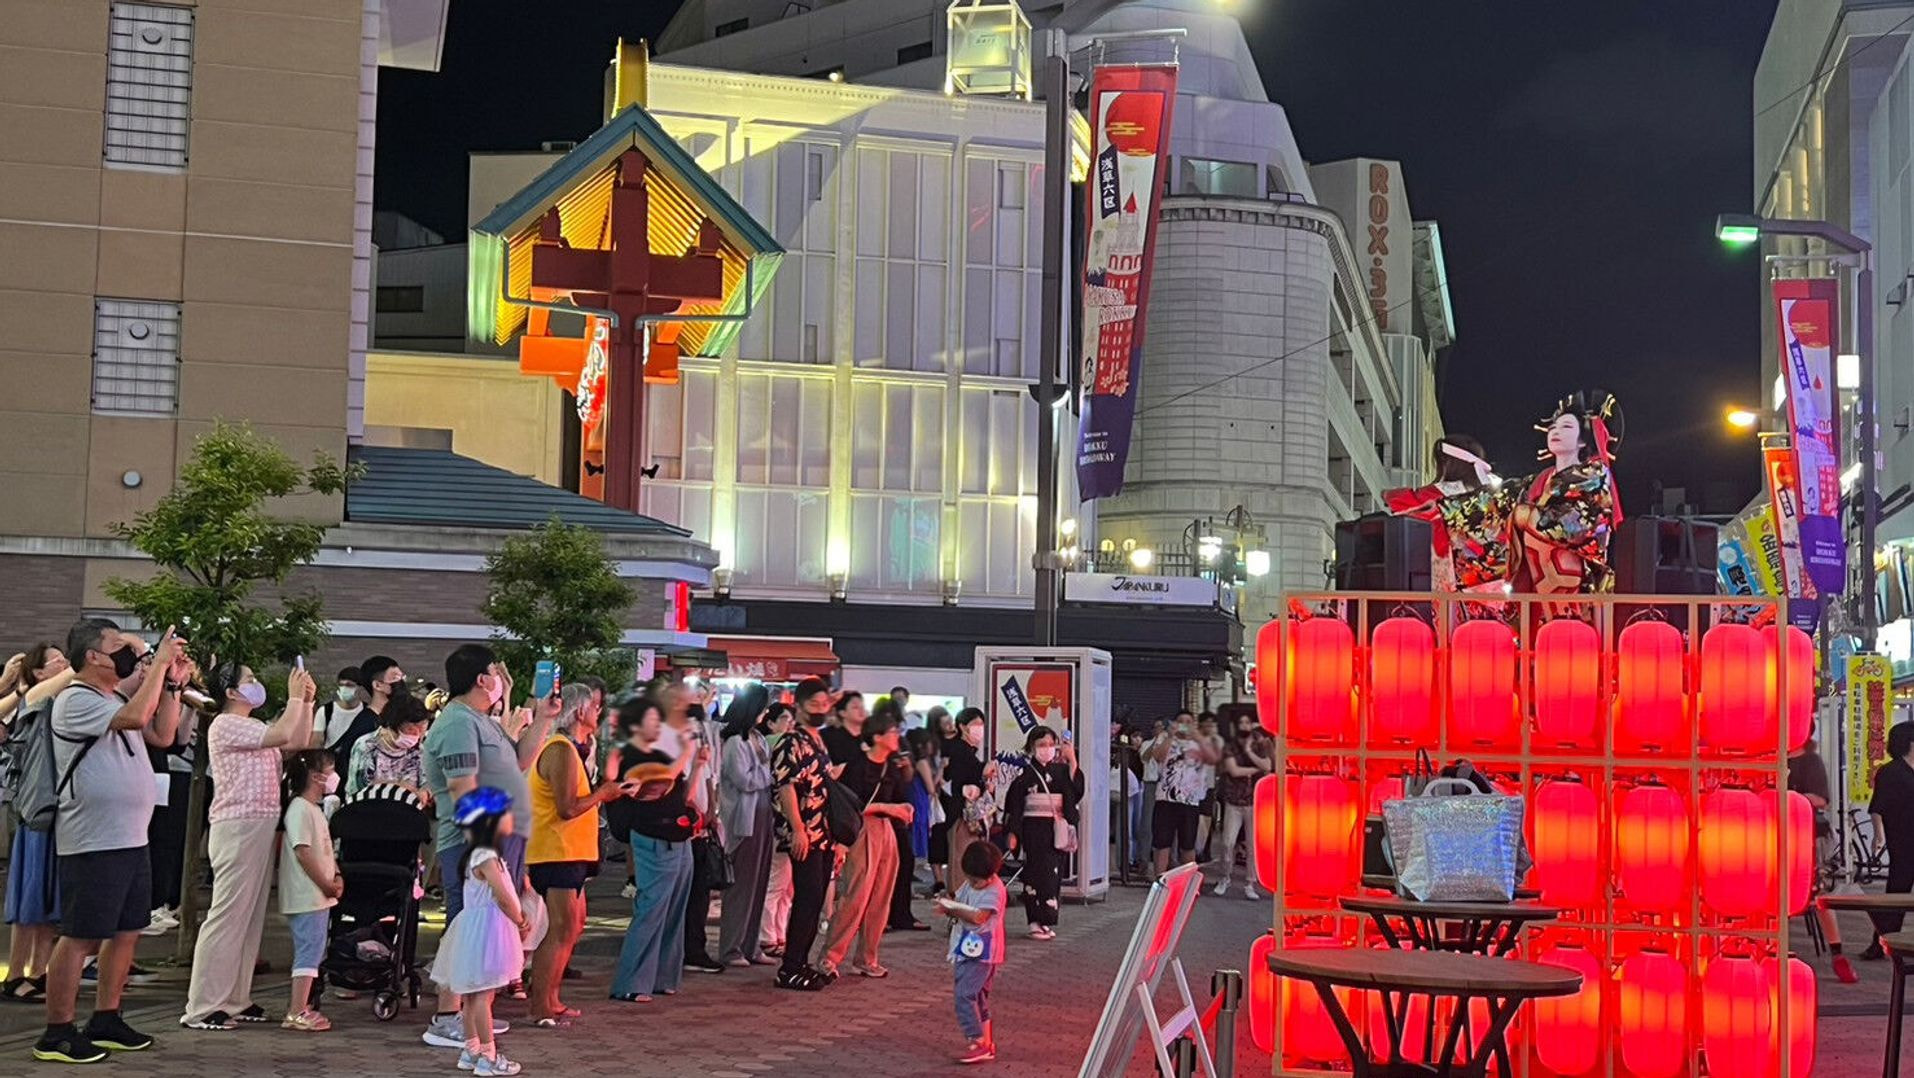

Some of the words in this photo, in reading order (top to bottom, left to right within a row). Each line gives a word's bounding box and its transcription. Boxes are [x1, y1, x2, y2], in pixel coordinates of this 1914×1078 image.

[1101, 157, 1116, 209] 浅草六区
[1005, 686, 1032, 727] 浅草六区
